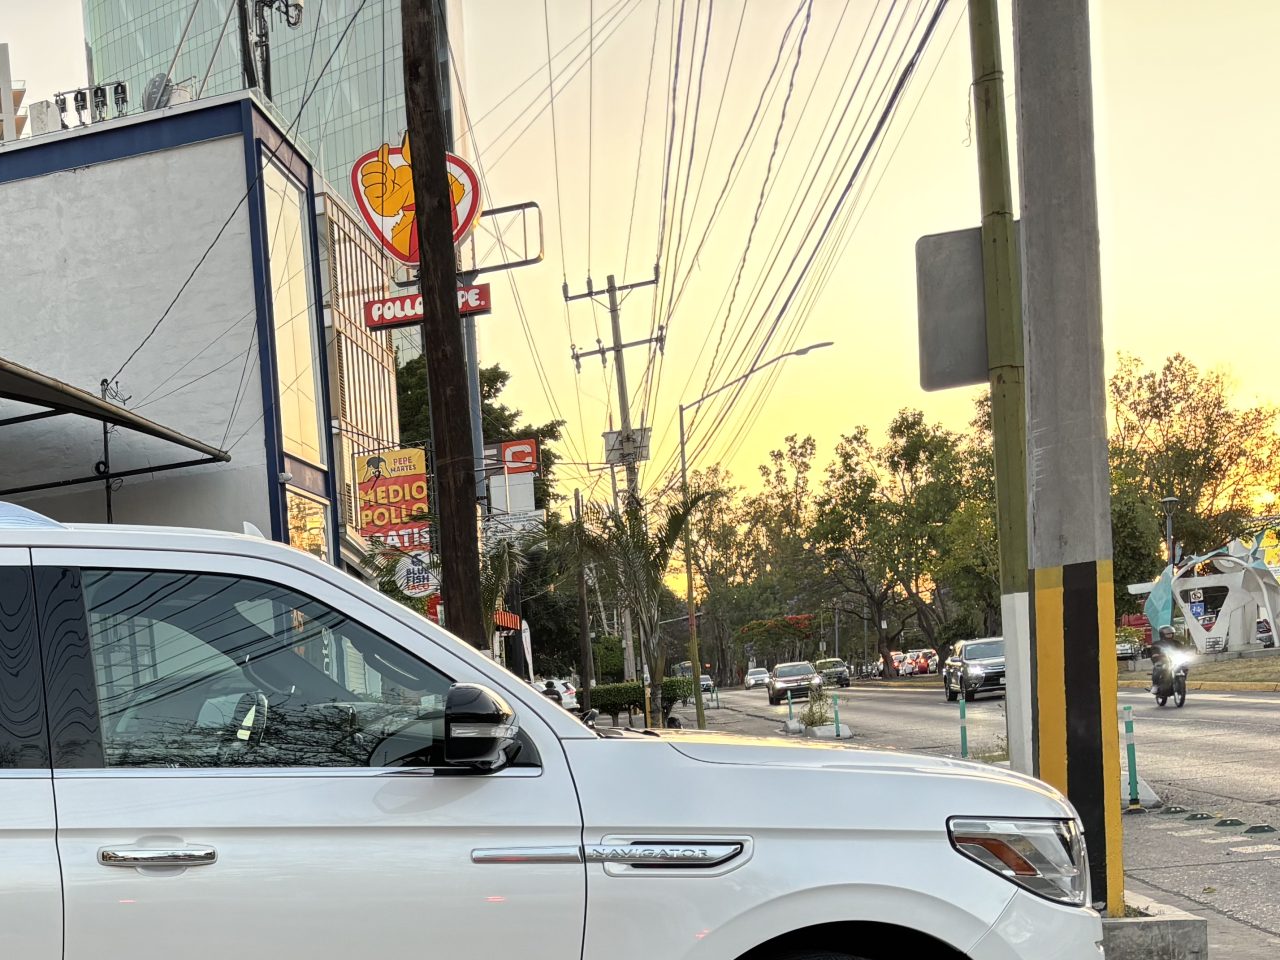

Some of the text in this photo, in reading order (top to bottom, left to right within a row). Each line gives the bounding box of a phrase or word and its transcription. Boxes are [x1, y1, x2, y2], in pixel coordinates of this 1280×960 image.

[359, 481, 428, 507] MEDIO
[371, 527, 431, 547] ATIS
[406, 575, 430, 584] FISH
[592, 848, 709, 858] NAVIGATOR
